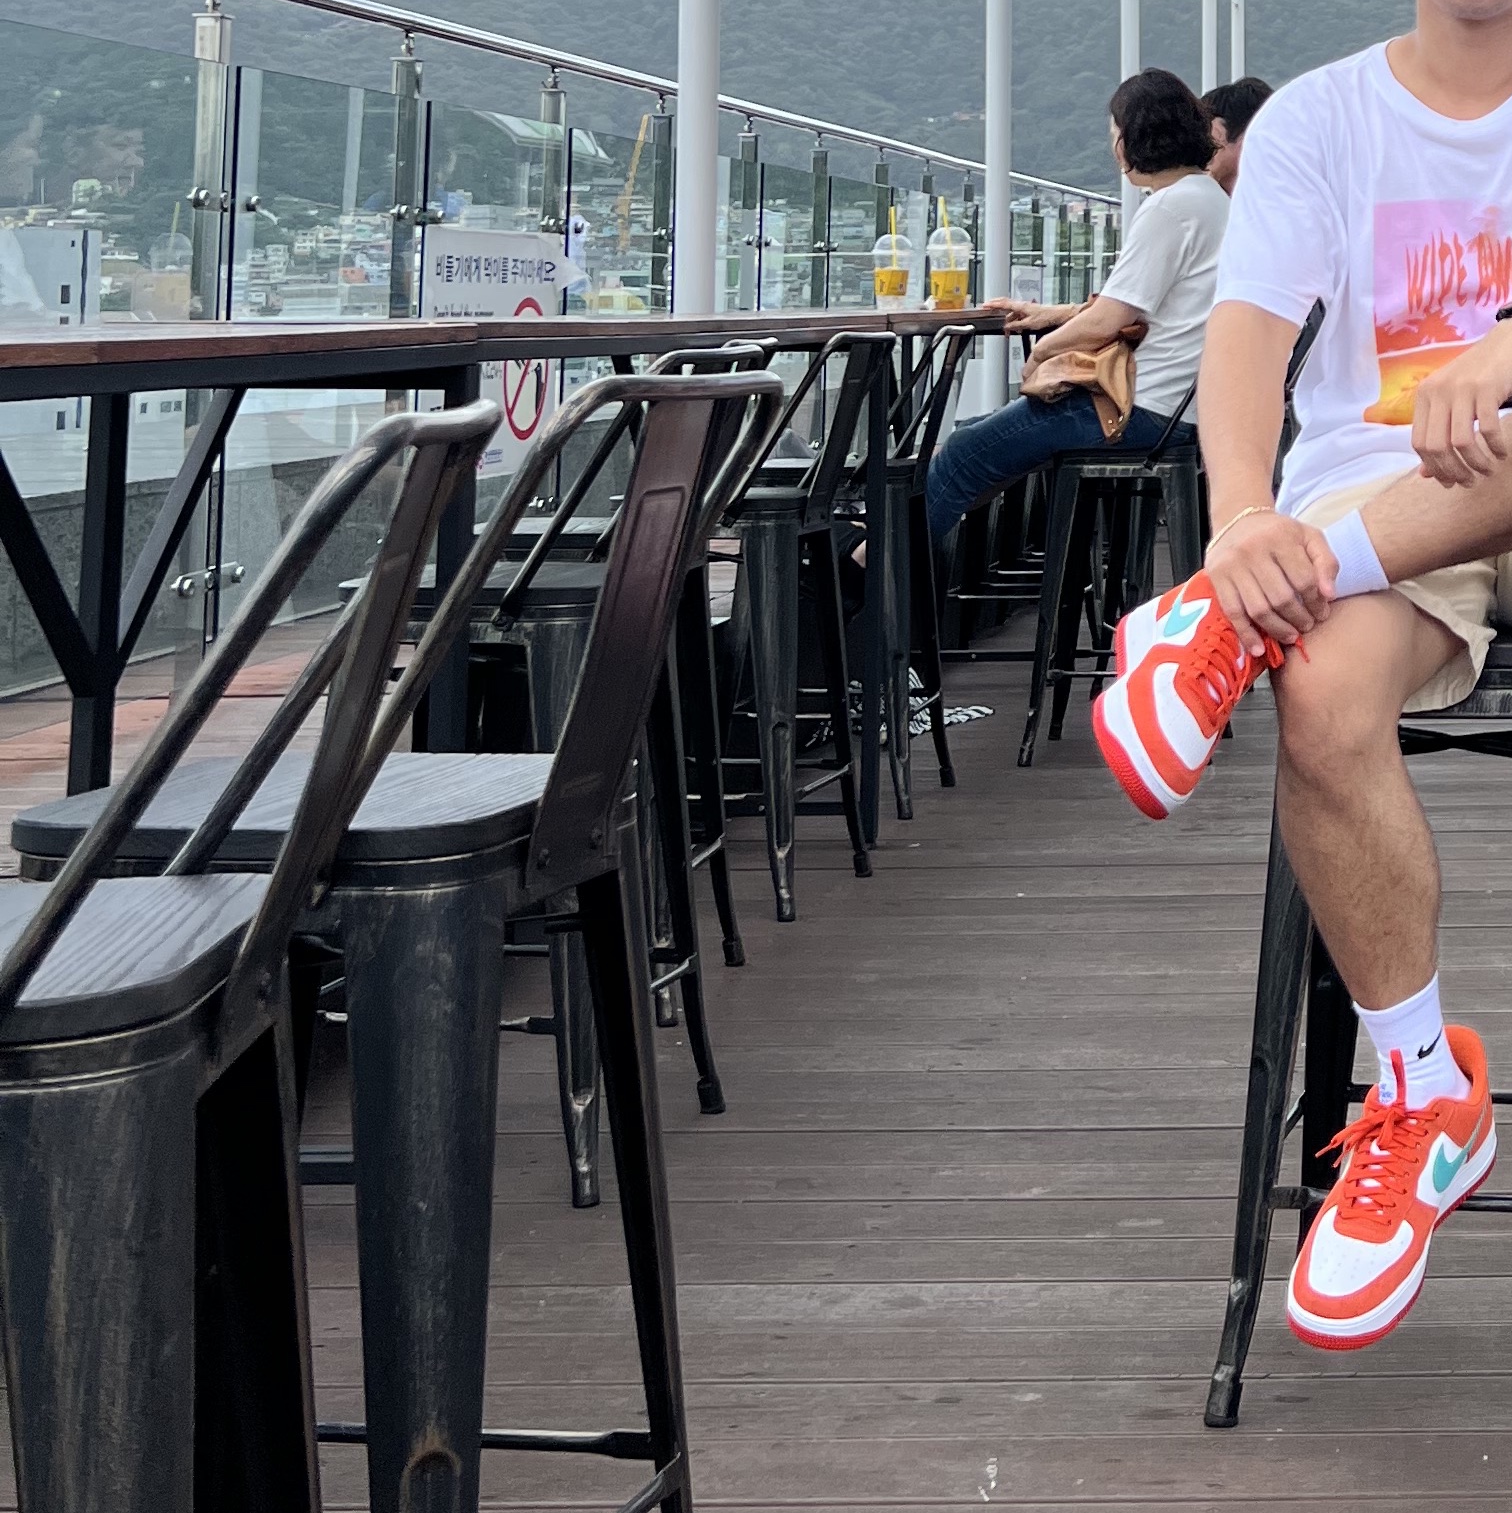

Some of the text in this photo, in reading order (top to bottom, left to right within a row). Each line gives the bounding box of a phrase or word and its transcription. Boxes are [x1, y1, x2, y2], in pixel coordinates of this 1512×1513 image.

[436, 254, 557, 285] 비둘기에게 먹이를 주지마세요
